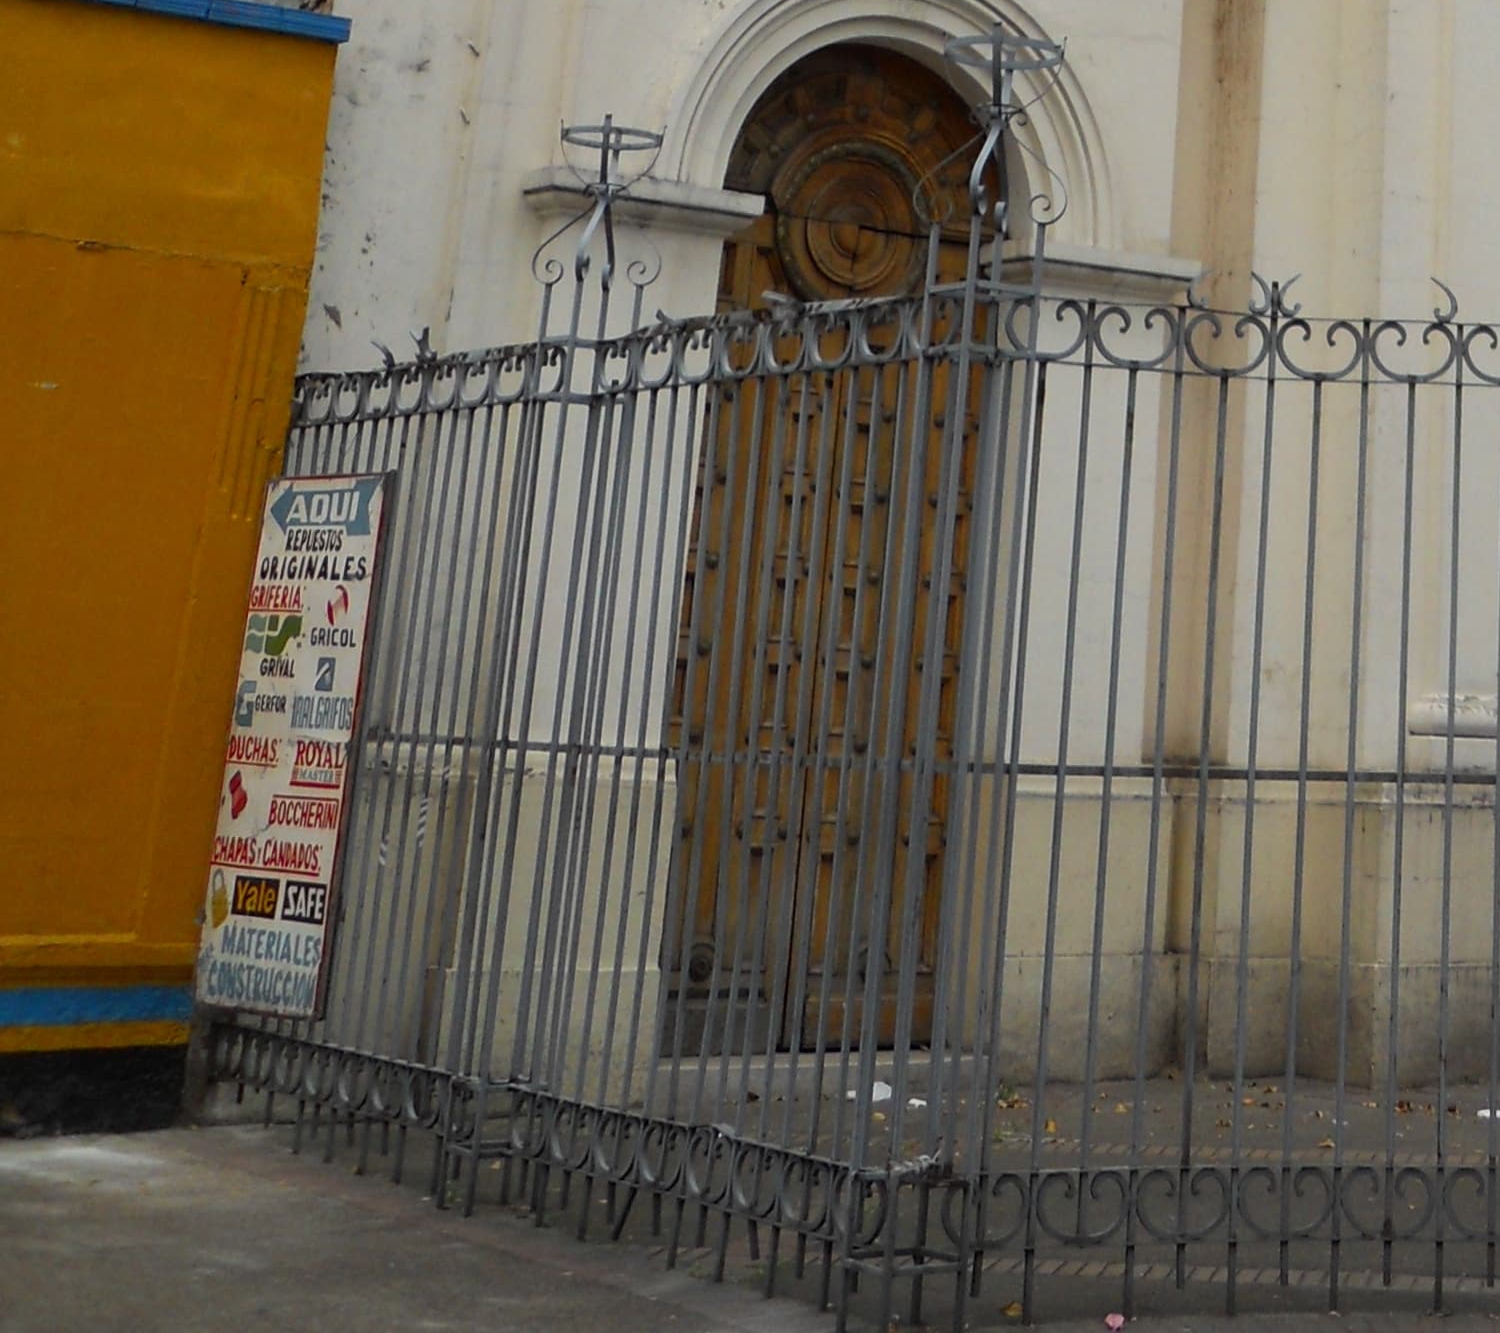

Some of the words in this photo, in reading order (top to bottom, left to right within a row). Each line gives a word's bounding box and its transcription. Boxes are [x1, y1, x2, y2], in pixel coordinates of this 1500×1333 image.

[286, 491, 360, 524] AQUI
[285, 528, 344, 552] REPUESTOS
[260, 555, 367, 582] ORIGINALES
[310, 627, 357, 648] GRICOL
[259, 657, 295, 678] GRIVAL
[294, 740, 346, 770] ROYAL
[268, 799, 336, 830] BOCCHERINI
[213, 835, 257, 865] CHAPAS
[236, 879, 276, 913] Yale
[283, 885, 325, 920] SAFE
[221, 923, 322, 968] MATERIALES
